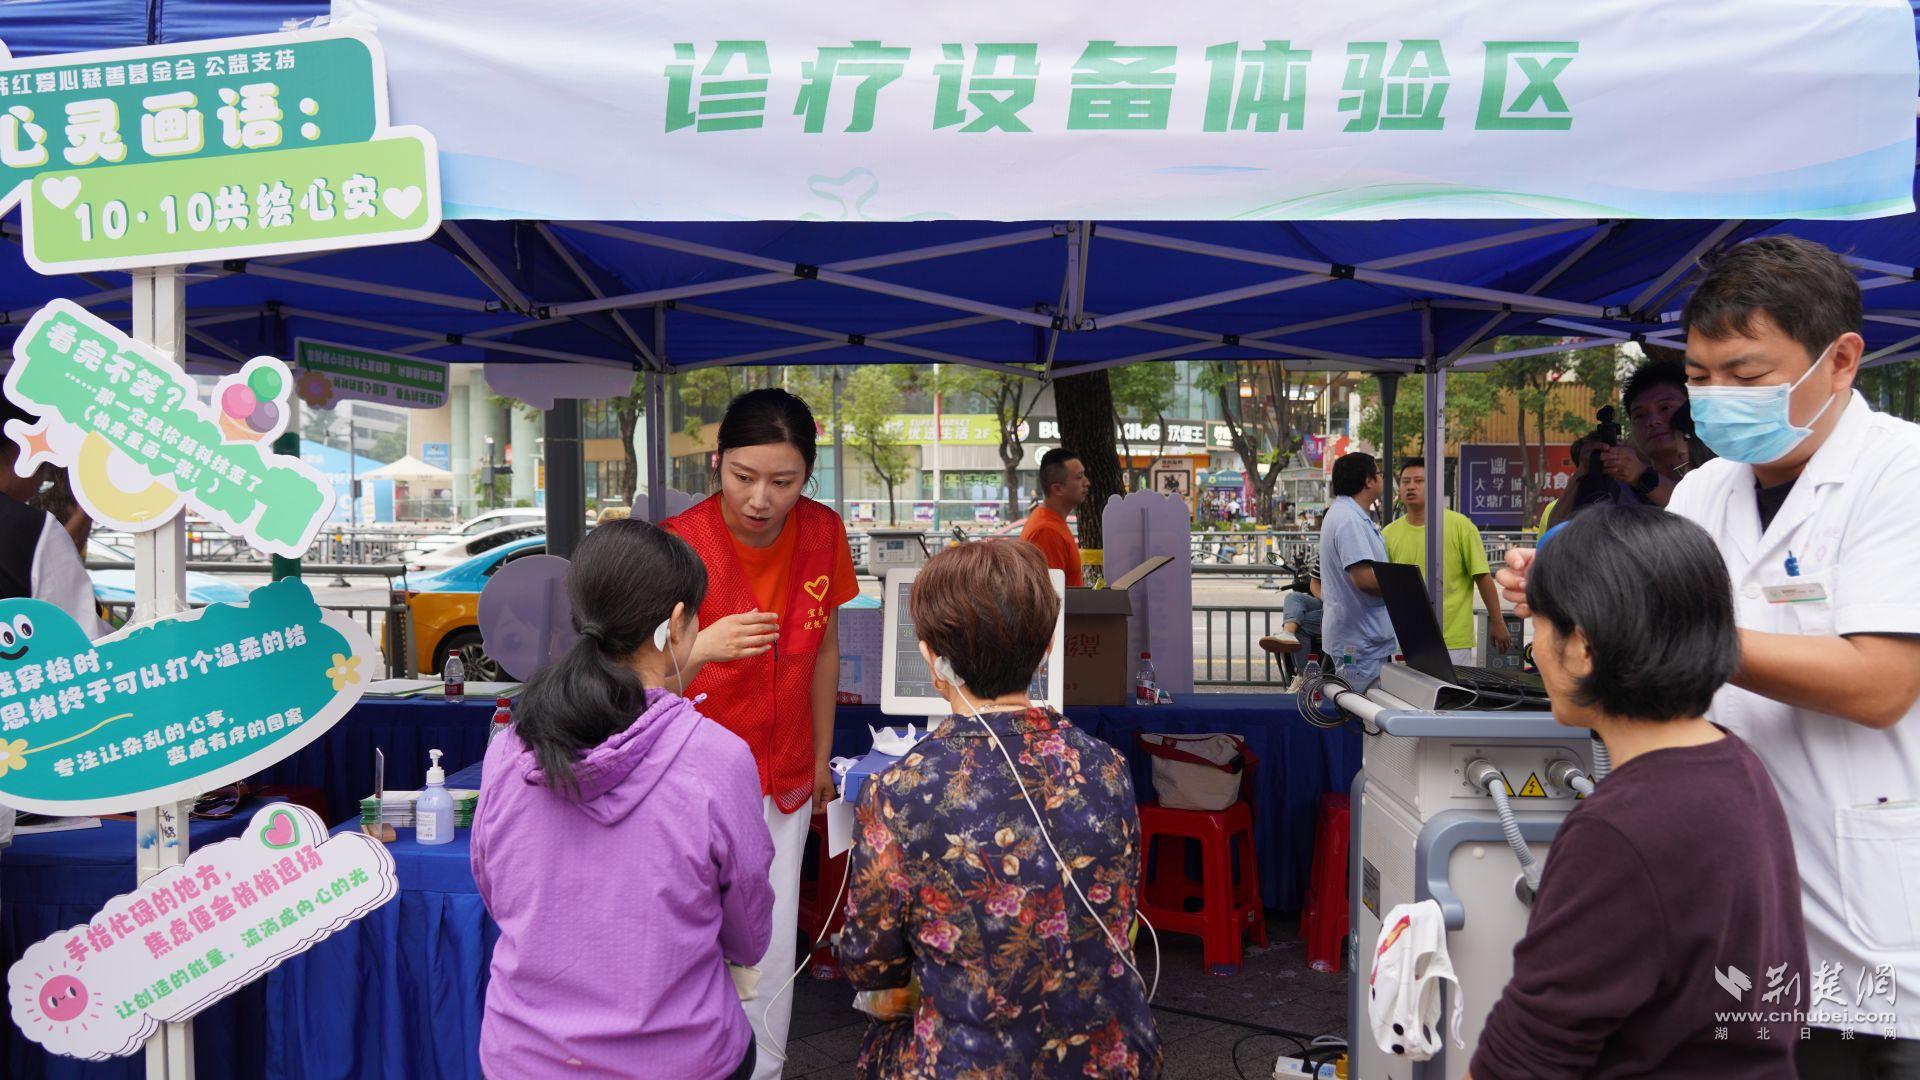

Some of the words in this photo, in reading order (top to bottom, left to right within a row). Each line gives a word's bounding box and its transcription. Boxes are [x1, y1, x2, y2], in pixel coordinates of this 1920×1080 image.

[663, 39, 1580, 134] 诊疗设备体验区
[47, 321, 183, 413] 看完不笑？
[1117, 423, 1160, 441] KING
[1475, 477, 1522, 492] 大学城
[1, 624, 307, 731] 思绪终于可以打个温柔的结
[166, 706, 304, 767] 变成有序的图案
[64, 862, 232, 963] 手指忙碌的地方，
[143, 844, 324, 959] 焦虑便会悄悄退场
